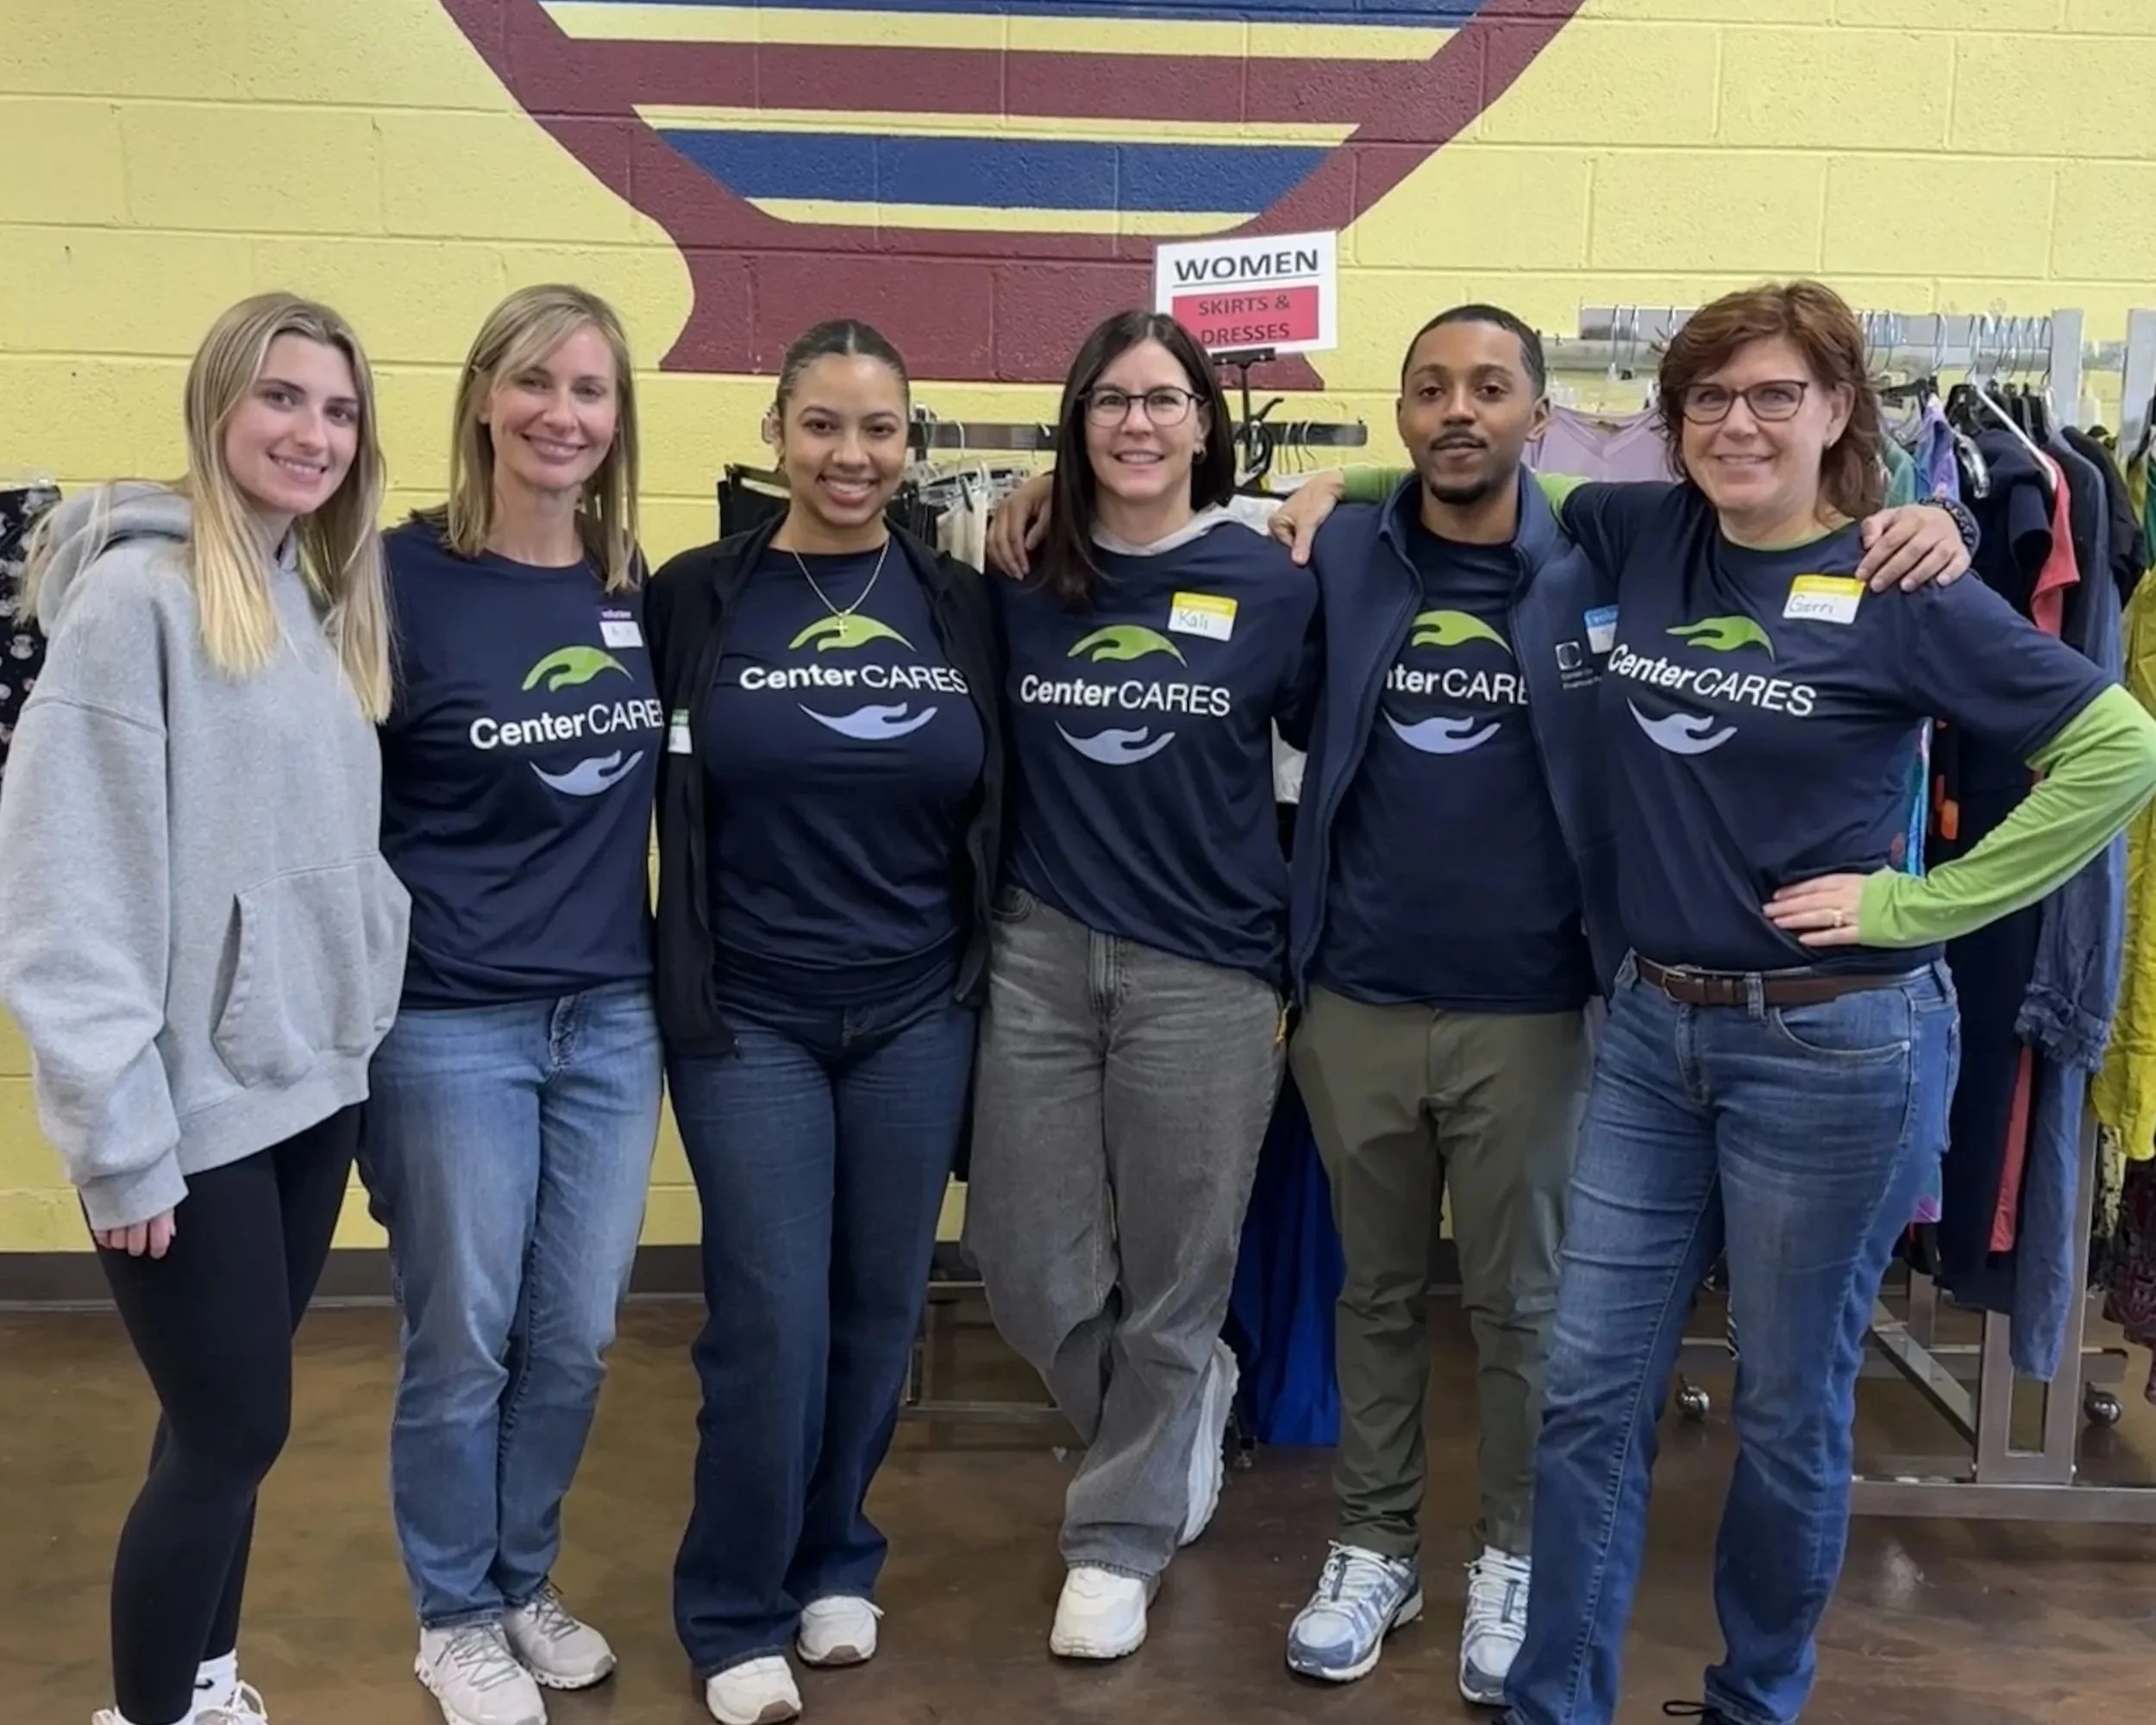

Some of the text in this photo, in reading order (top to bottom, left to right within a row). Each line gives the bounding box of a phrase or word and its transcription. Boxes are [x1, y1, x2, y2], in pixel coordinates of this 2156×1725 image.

[1175, 249, 1319, 281] WOMEN
[1198, 294, 1291, 317] SKIRTS &
[1200, 323, 1290, 345] DRESSES
[1789, 593, 1839, 614] Gerri
[1179, 609, 1208, 631] Kali
[739, 663, 968, 694] CenterCARES
[1608, 643, 1817, 717] CenterCARES
[1020, 674, 1231, 717] CenterCARES
[470, 699, 664, 749] CenterCARE
